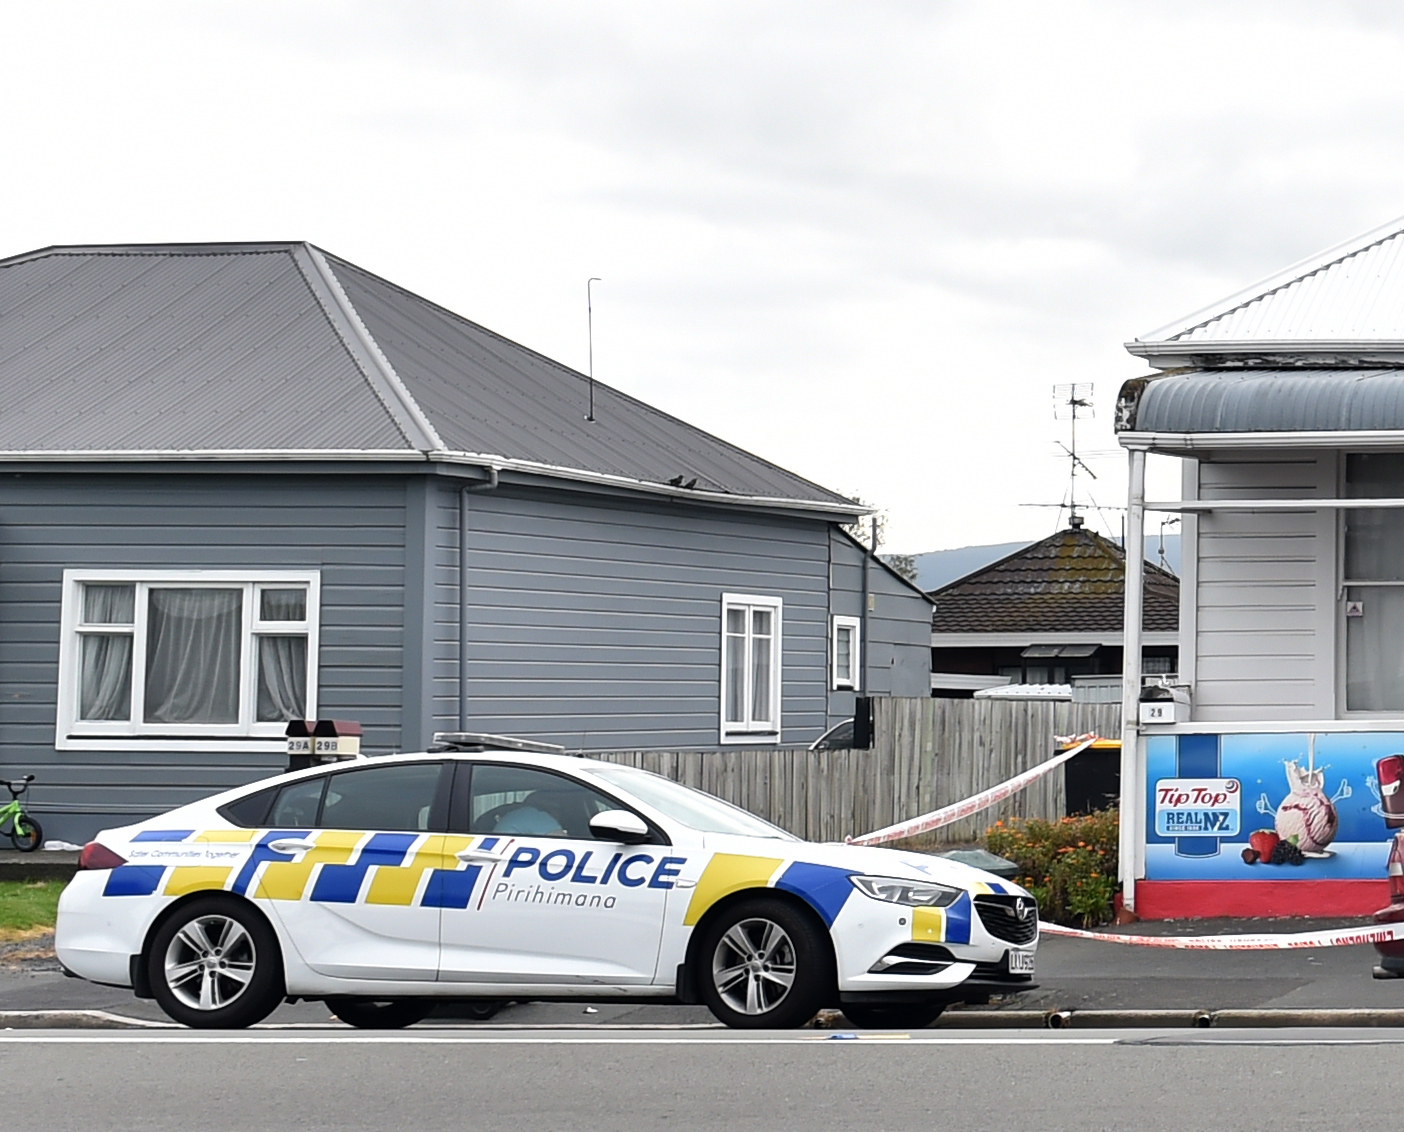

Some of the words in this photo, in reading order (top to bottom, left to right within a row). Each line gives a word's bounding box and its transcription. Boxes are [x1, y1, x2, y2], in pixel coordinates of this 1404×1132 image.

[1150, 708, 1163, 717] 29
[288, 741, 309, 751] 29A
[316, 741, 338, 751] 29B
[1158, 788, 1190, 807] Tip
[1191, 788, 1228, 807] Top
[1166, 812, 1202, 825] REAL
[1203, 812, 1230, 831] NZ
[151, 850, 202, 858] Communities
[205, 849, 240, 859] Together
[502, 846, 688, 889] POLICE
[492, 882, 617, 909] Pirihimana
